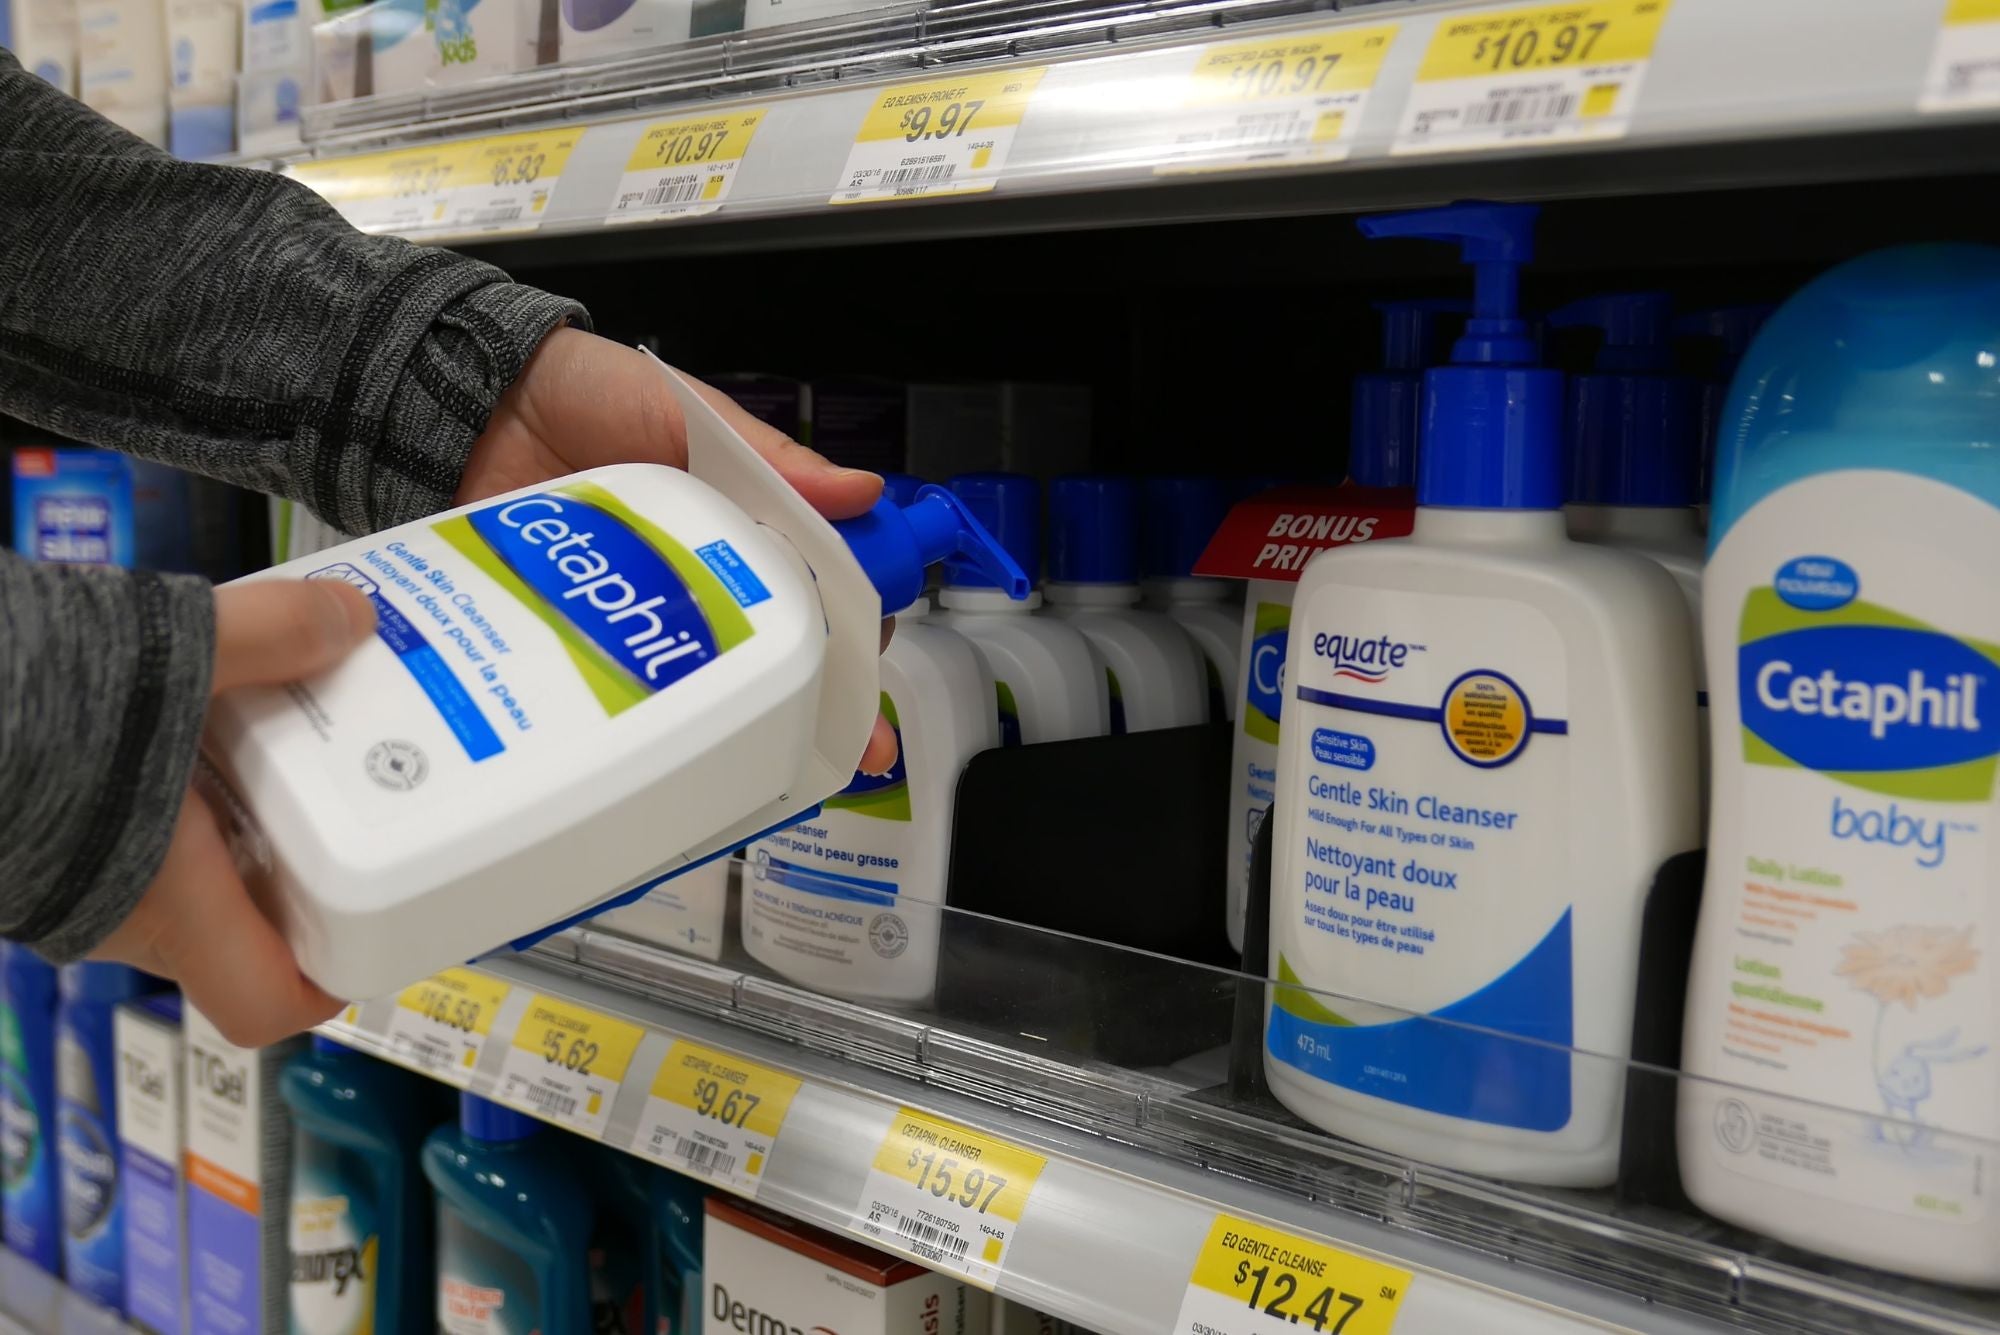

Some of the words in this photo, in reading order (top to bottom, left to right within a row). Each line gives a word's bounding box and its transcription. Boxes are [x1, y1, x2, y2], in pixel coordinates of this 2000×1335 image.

[1472, 22, 1608, 70] $10.97
[895, 92, 929, 107] BLEMISH
[929, 88, 957, 103] PRONE
[900, 100, 985, 143] $9.97
[656, 131, 729, 164] $10.97
[1267, 514, 1379, 542] BONUS
[361, 549, 423, 595] Nettoyant
[711, 541, 740, 568] Save
[385, 541, 430, 573] Gentle
[425, 568, 456, 596] Skin
[451, 591, 513, 655] Cleanser
[415, 592, 452, 627] doux
[498, 498, 703, 681] Cetaphil
[445, 626, 487, 665] pour
[1314, 632, 1408, 669] equate
[480, 660, 499, 683] la
[488, 681, 533, 732] peau
[1756, 660, 1981, 740] Cetaphil
[1315, 745, 1333, 760] Peau
[1333, 752, 1367, 767] sensible
[1316, 731, 1349, 749] Sensitive
[1350, 738, 1369, 753] Skin
[1308, 774, 1362, 806] Gentle
[1368, 787, 1409, 816] Skin
[1416, 796, 1519, 831] Cleanser
[1308, 808, 1325, 822] Mild
[1326, 812, 1359, 832] Enough
[1360, 820, 1377, 834] For
[1379, 825, 1394, 838] All
[1396, 827, 1428, 845] Types
[1430, 832, 1446, 846] Of
[1449, 836, 1475, 850] Skin
[1830, 796, 1945, 868] baby
[792, 840, 812, 853] pour
[814, 842, 823, 856] la
[825, 848, 854, 863] peau
[857, 854, 899, 869] grasse
[1306, 837, 1396, 879] Nettoyant
[1403, 859, 1458, 890] doux
[1746, 855, 1786, 881] Daily
[1789, 863, 1844, 888] Lotion
[1305, 870, 1341, 893] pour
[1345, 876, 1361, 902] la
[1366, 888, 1415, 913] peau
[1304, 899, 1326, 916] Assez
[1327, 906, 1349, 922] doux
[1351, 914, 1374, 928] pour
[1376, 918, 1397, 934] être
[1400, 925, 1436, 942] utilisé
[1304, 915, 1317, 926] sur
[1317, 918, 1335, 933] tous
[1337, 923, 1350, 937] les
[1352, 928, 1379, 945] types
[1381, 935, 1395, 949] de
[1396, 941, 1425, 955] peau
[1734, 955, 1783, 979] Lotion
[543, 1029, 599, 1076] $5.62
[1297, 1033, 1316, 1055] 473
[693, 1078, 760, 1129] $9.67
[902, 1123, 939, 1147] CETAPHIL
[939, 1136, 982, 1162] CLEANSER
[907, 1148, 1007, 1215] $15.97
[868, 1210, 882, 1224] AS
[1222, 1231, 1238, 1249] EQ
[1238, 1235, 1279, 1262] GENTLE
[1279, 1249, 1327, 1278] CLEANSE
[1234, 1259, 1364, 1335] $12.47
[1379, 1285, 1397, 1301] SM
